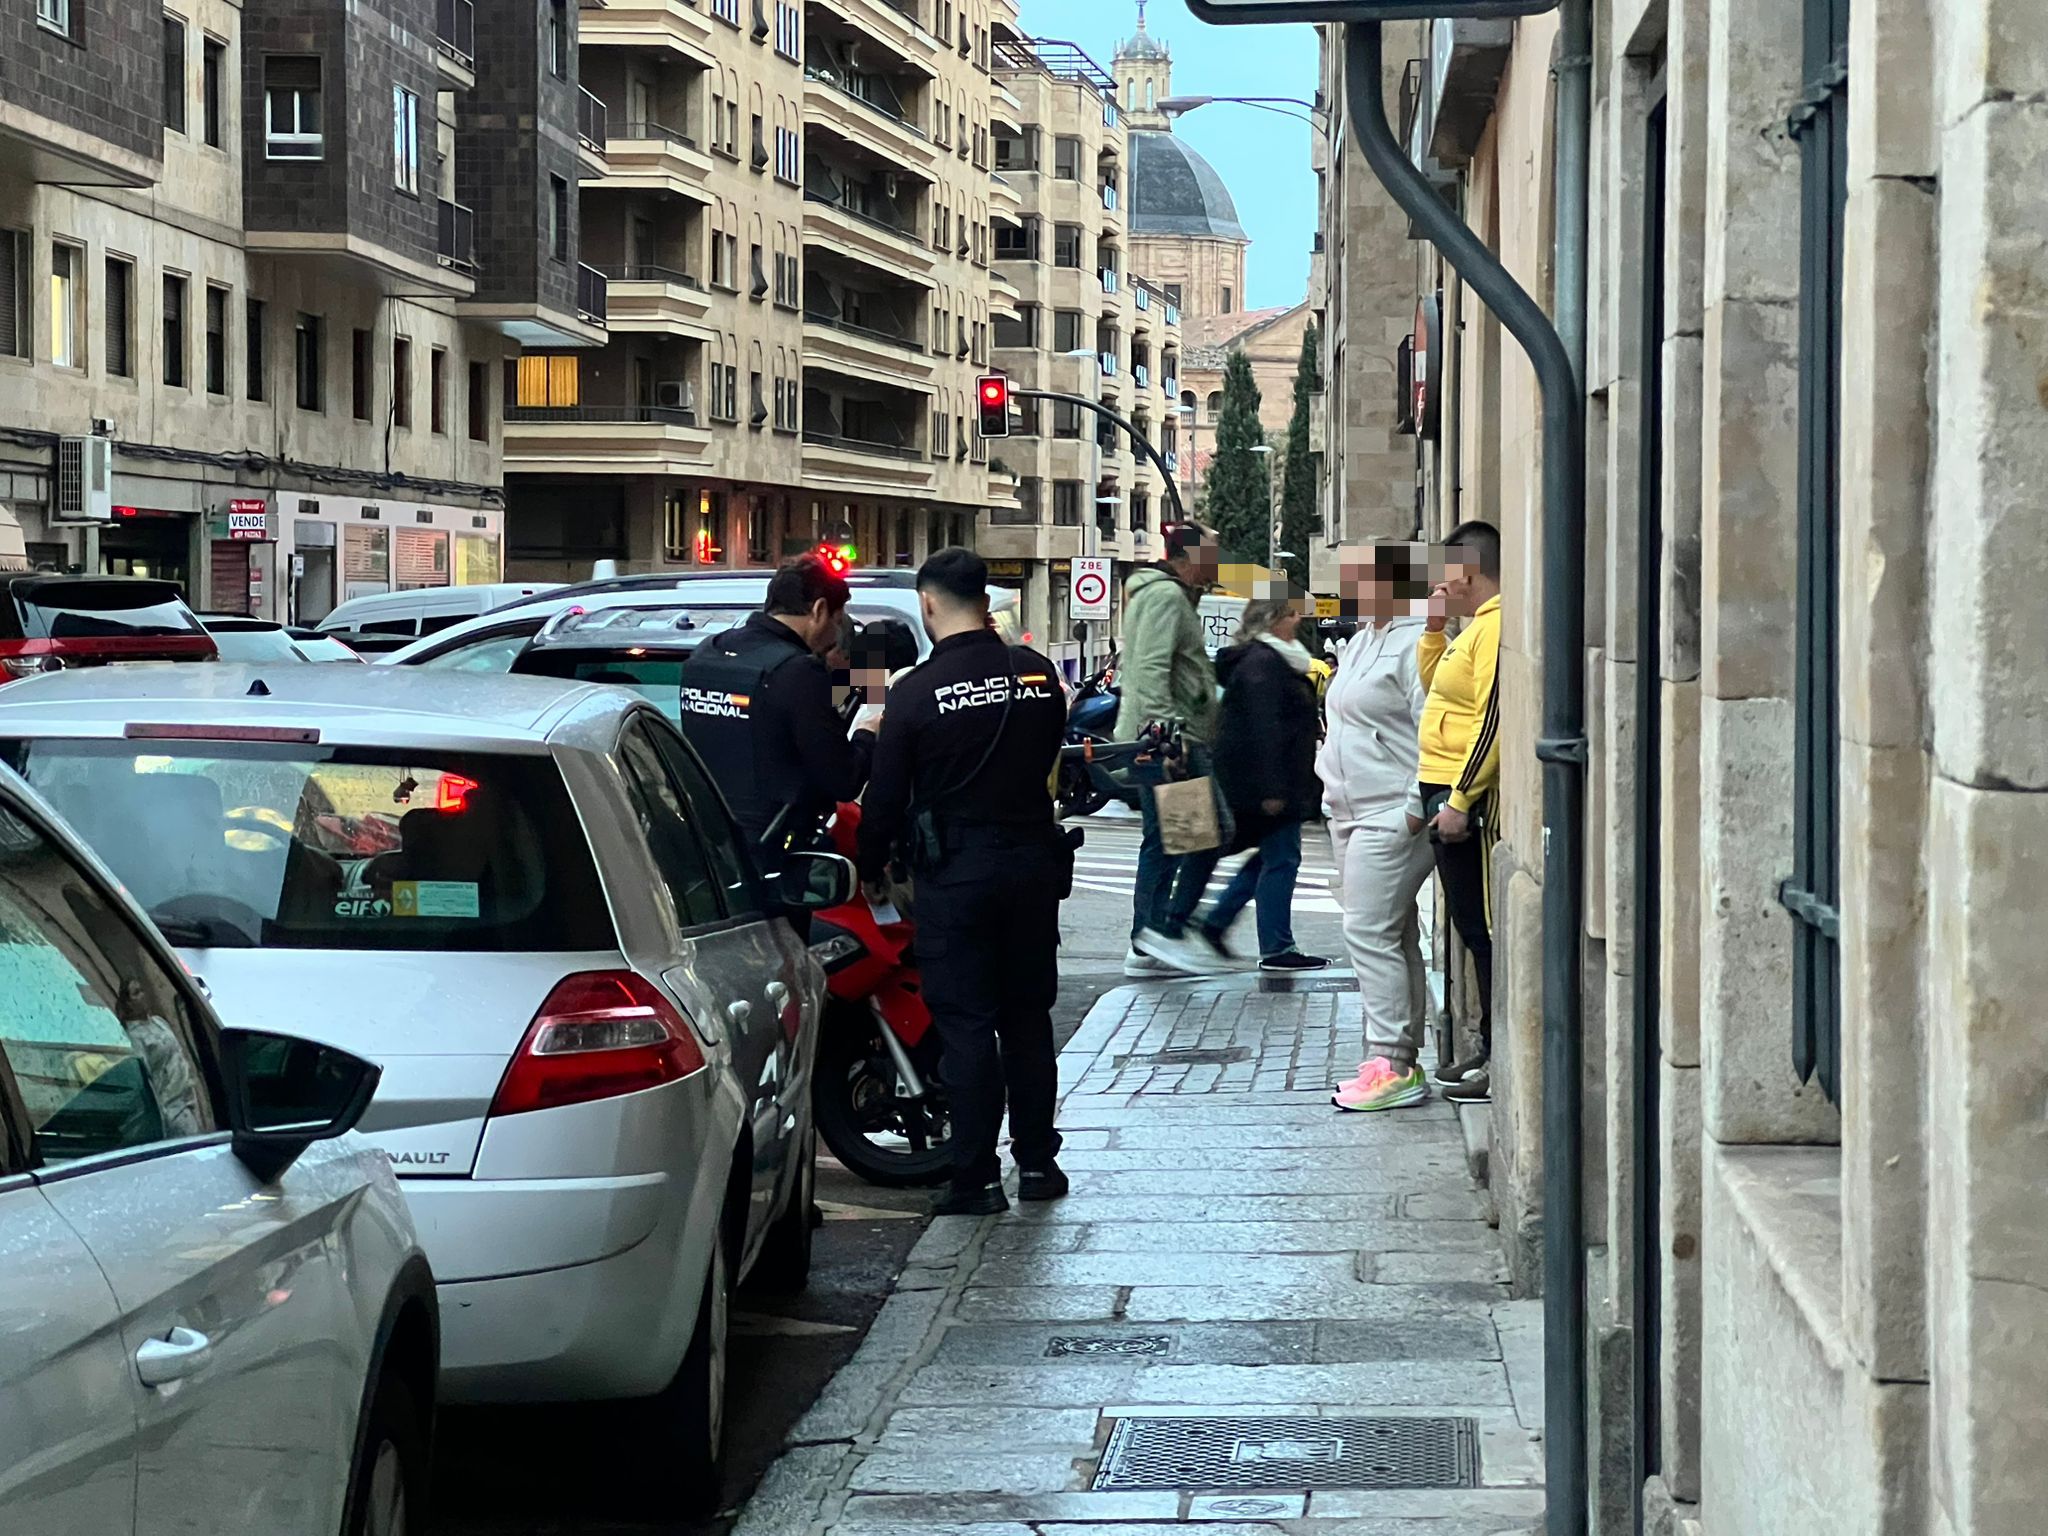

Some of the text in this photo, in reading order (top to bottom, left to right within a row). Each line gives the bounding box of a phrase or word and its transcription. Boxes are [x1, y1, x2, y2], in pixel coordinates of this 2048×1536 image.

[231, 516, 264, 527] VENDE
[1080, 561, 1103, 570] ZBE
[681, 687, 733, 705] POLICIA
[681, 700, 750, 719] NACIONAL
[334, 900, 371, 916] elf
[385, 1152, 450, 1164] NAULT
